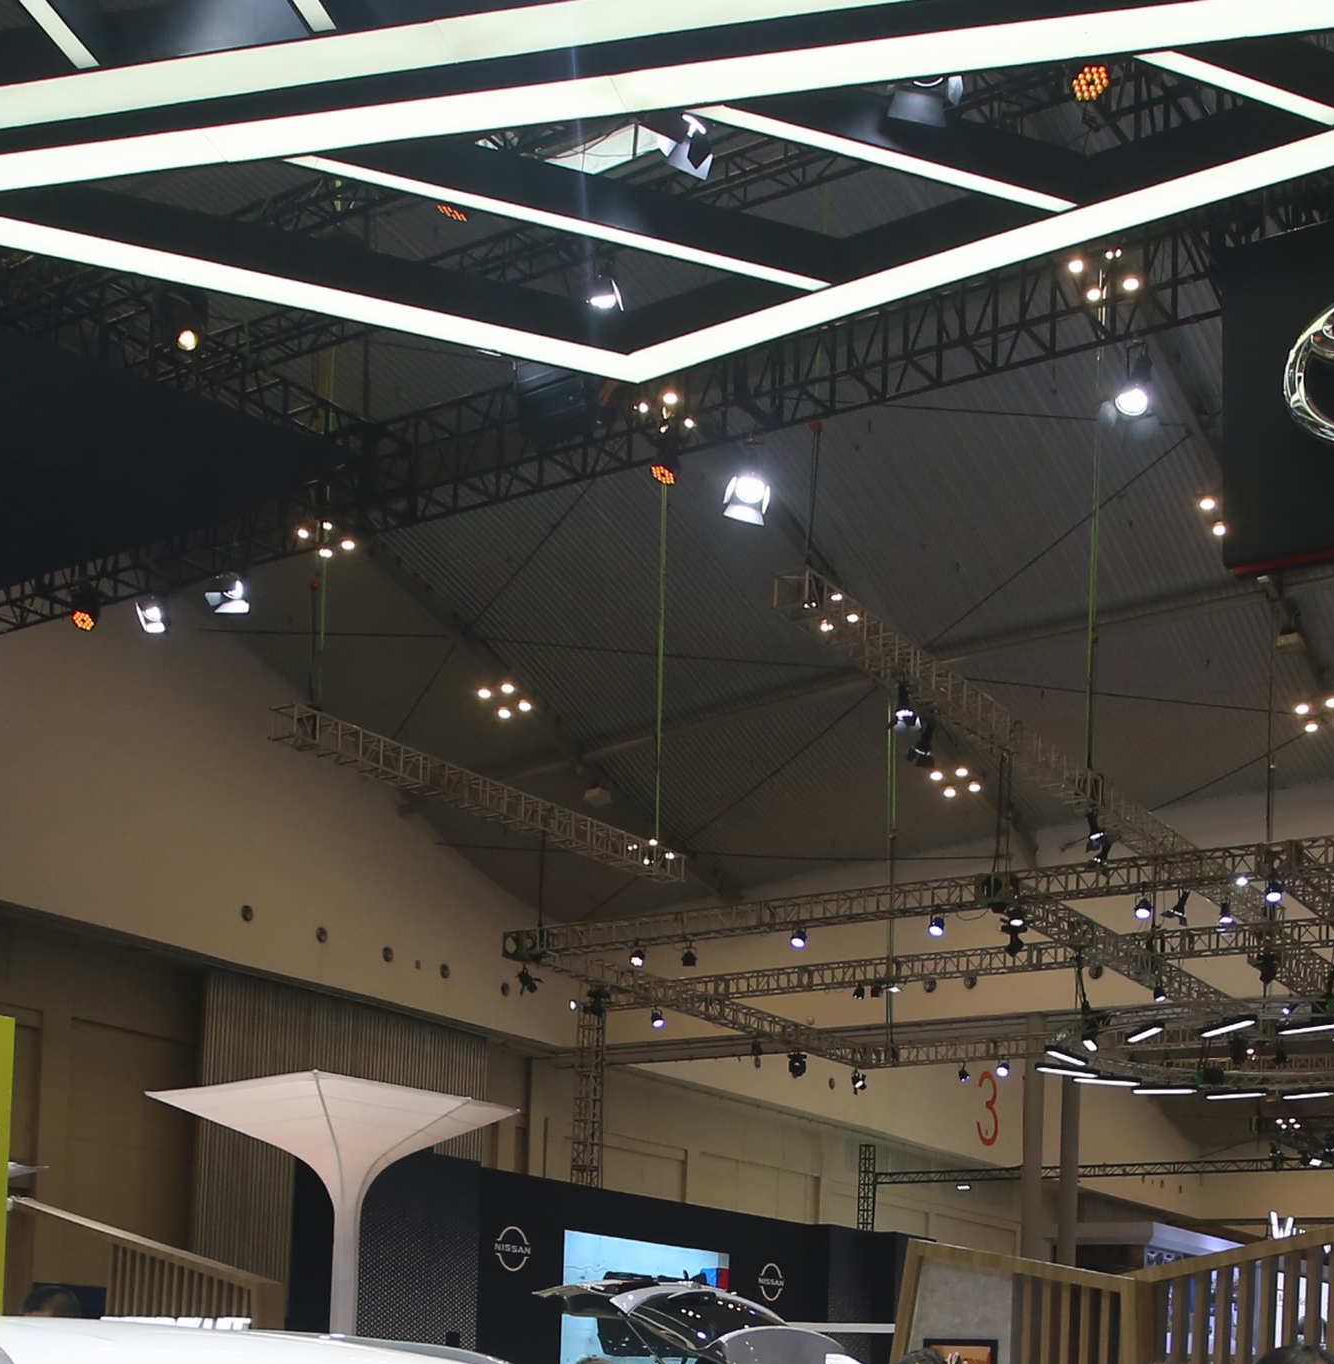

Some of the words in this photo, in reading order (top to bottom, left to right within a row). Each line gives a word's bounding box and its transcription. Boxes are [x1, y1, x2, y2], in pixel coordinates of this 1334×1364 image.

[976, 1070, 998, 1146] 3
[494, 1242, 531, 1255] NISSAN
[758, 1276, 784, 1287] NISSAN
